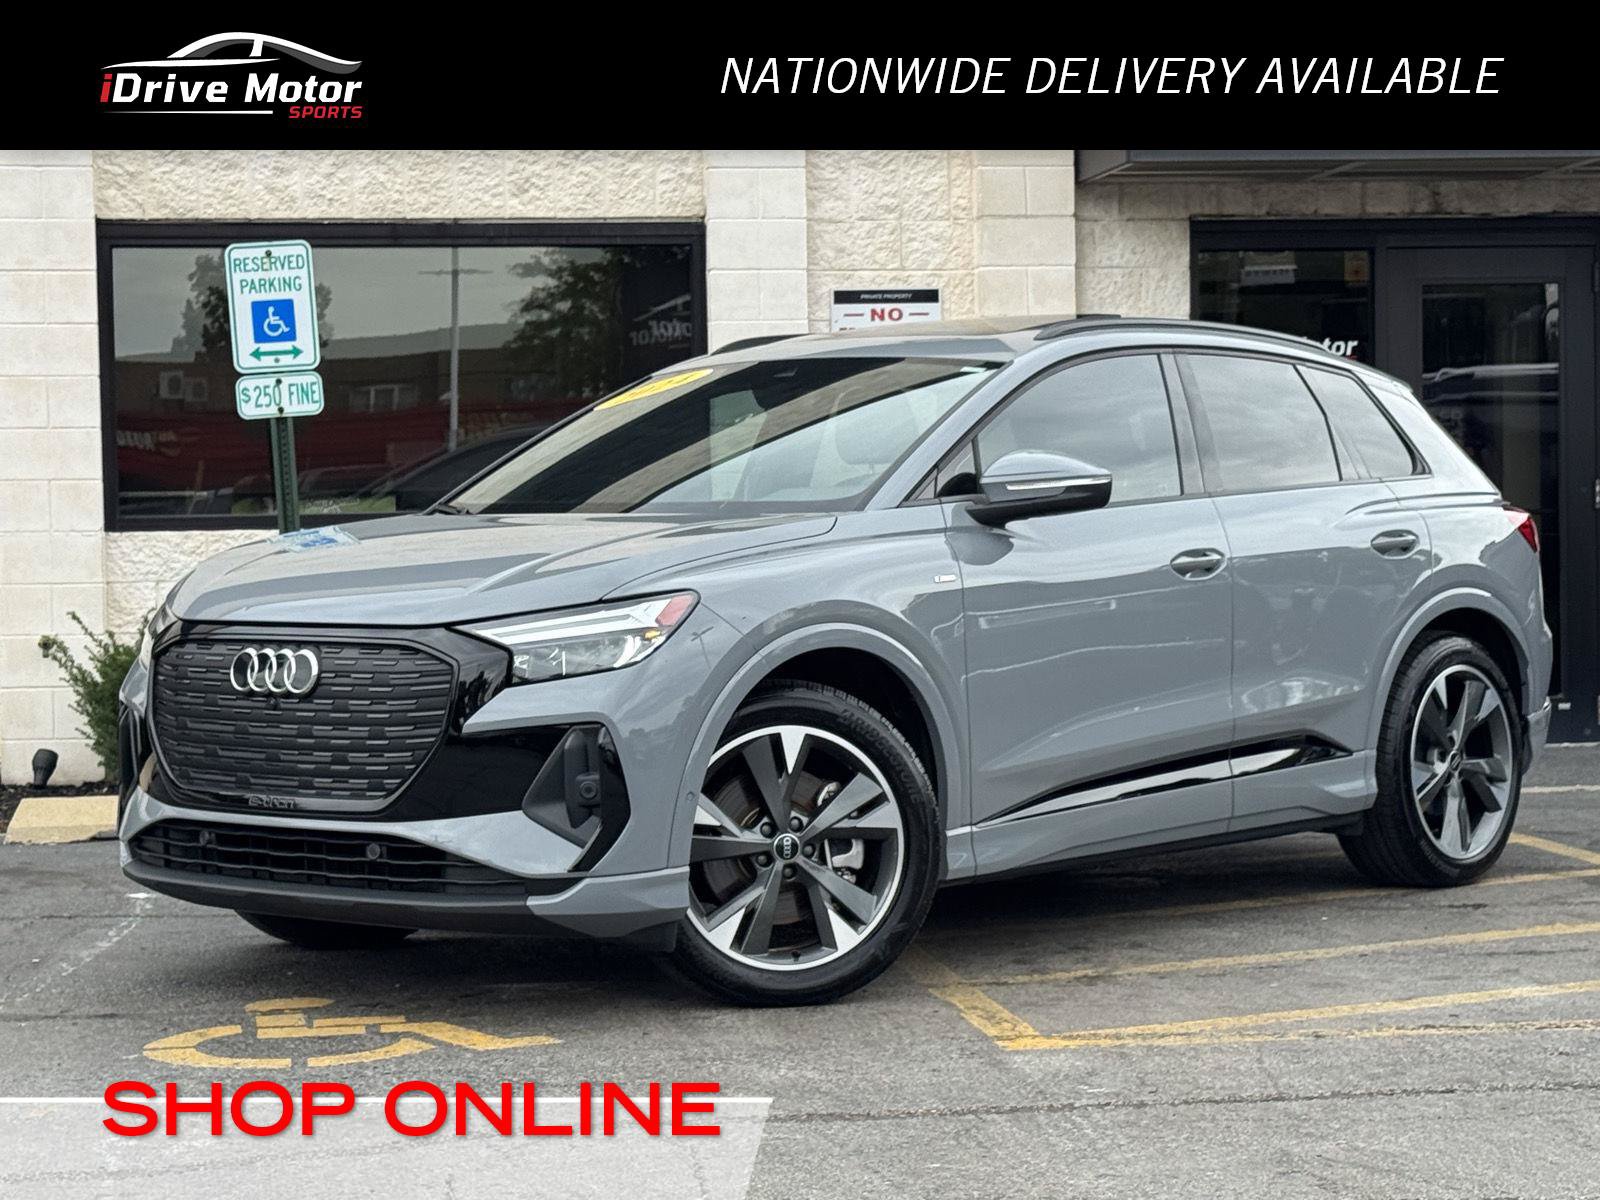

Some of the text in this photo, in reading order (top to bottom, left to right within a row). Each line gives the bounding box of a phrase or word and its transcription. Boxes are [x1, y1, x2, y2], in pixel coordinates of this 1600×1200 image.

[233, 254, 305, 273] RESERVED
[240, 276, 302, 294] PARKING
[870, 307, 904, 322] NO
[241, 381, 319, 409] $250 FINE
